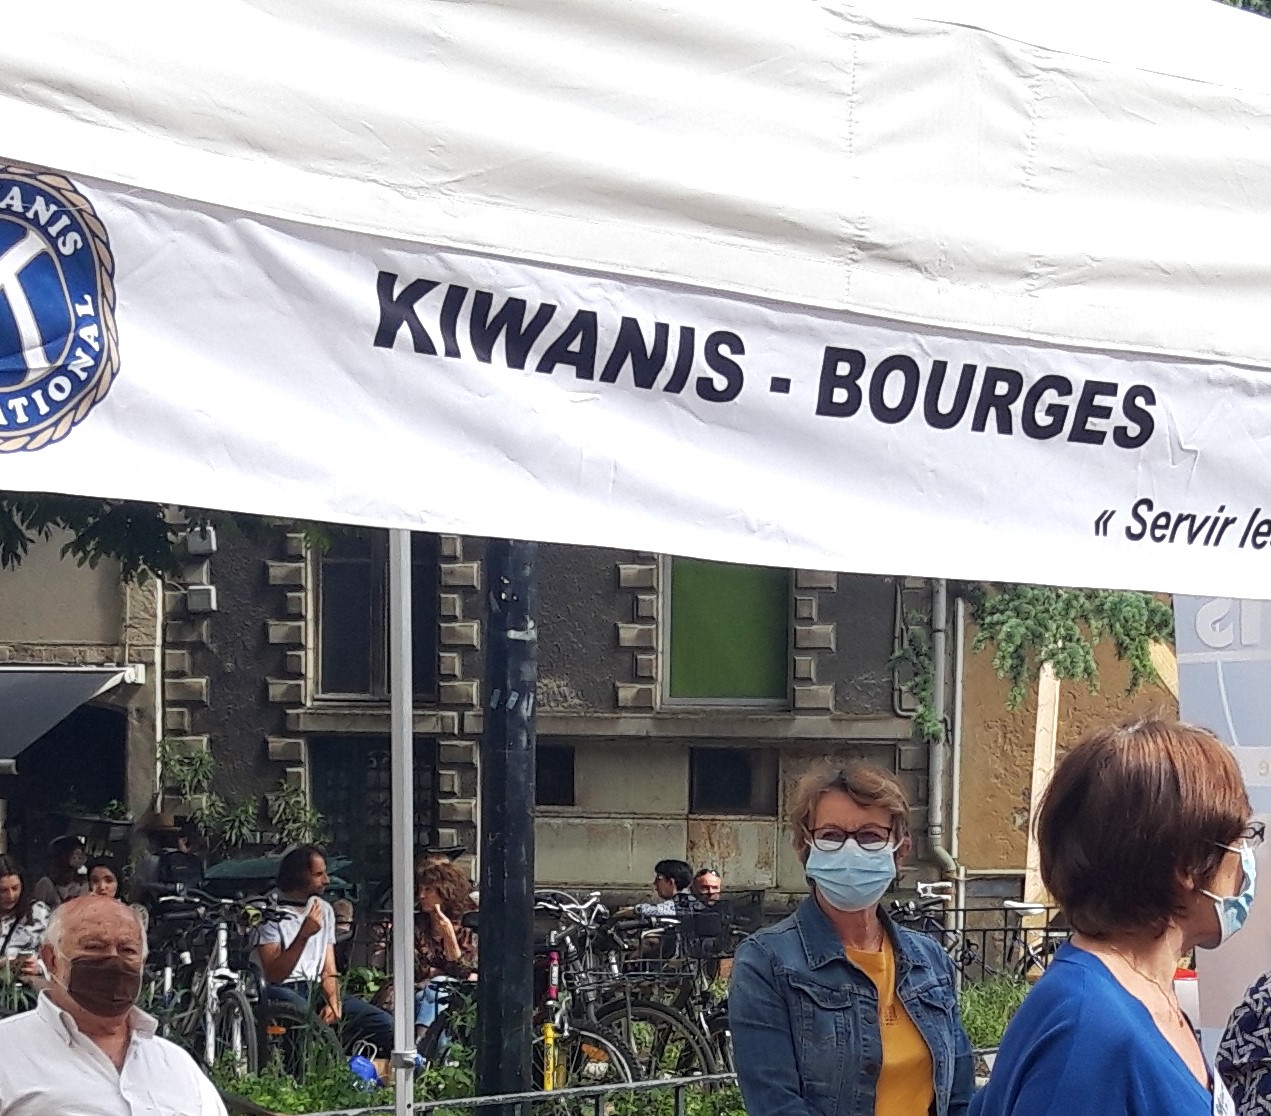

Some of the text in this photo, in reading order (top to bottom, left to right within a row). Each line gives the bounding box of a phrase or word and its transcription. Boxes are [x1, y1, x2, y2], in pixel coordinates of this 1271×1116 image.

[373, 270, 1157, 450] KIWANIS - BOURGES
[1125, 498, 1236, 548] Servir
